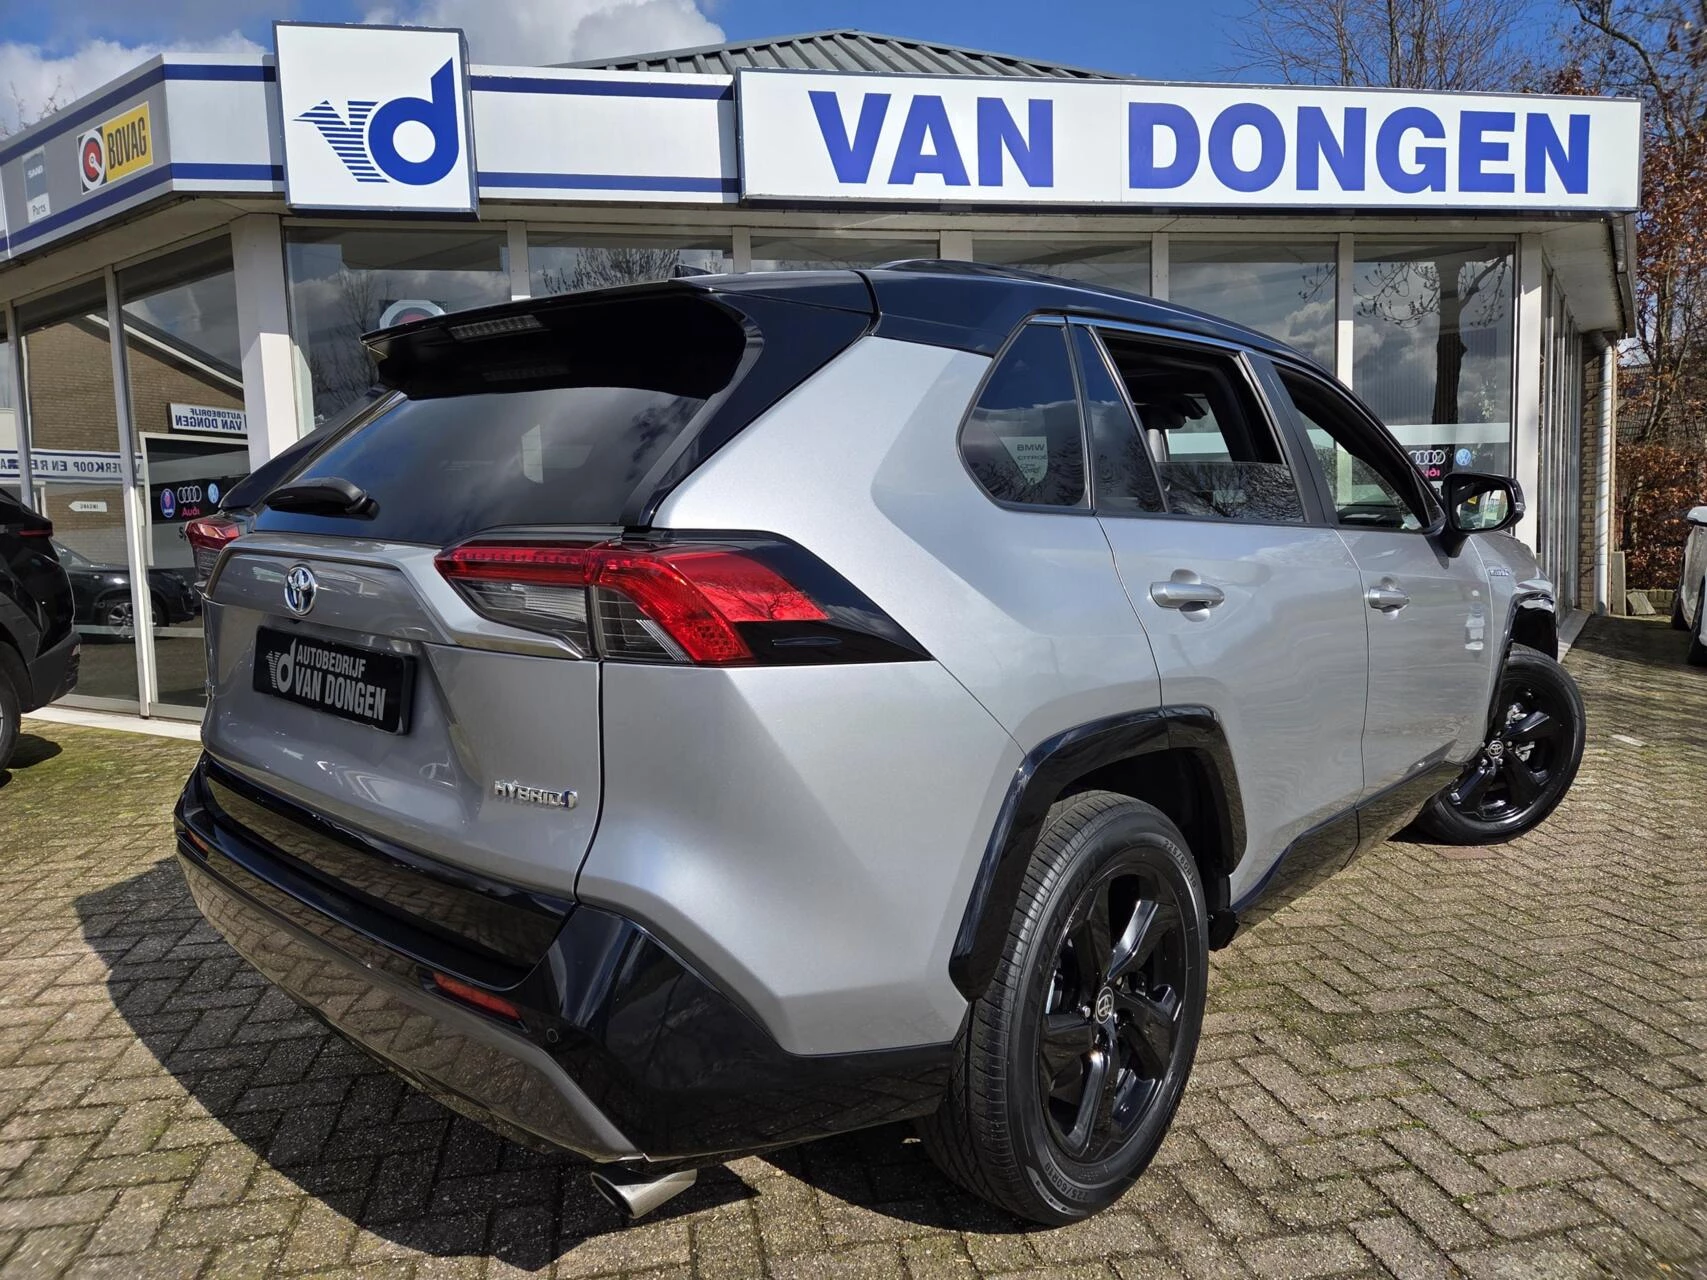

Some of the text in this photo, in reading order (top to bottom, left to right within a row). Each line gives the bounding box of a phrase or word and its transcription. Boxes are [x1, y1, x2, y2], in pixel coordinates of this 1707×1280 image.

[107, 116, 147, 170] BOVAG
[809, 91, 1591, 195] VAN DONGEN
[1017, 443, 1045, 451] BMW
[181, 506, 201, 517] Audi
[296, 644, 366, 679] AUTOBEDRIJF
[294, 665, 387, 721] VAN DONGEN
[494, 779, 562, 806] HYBRID
